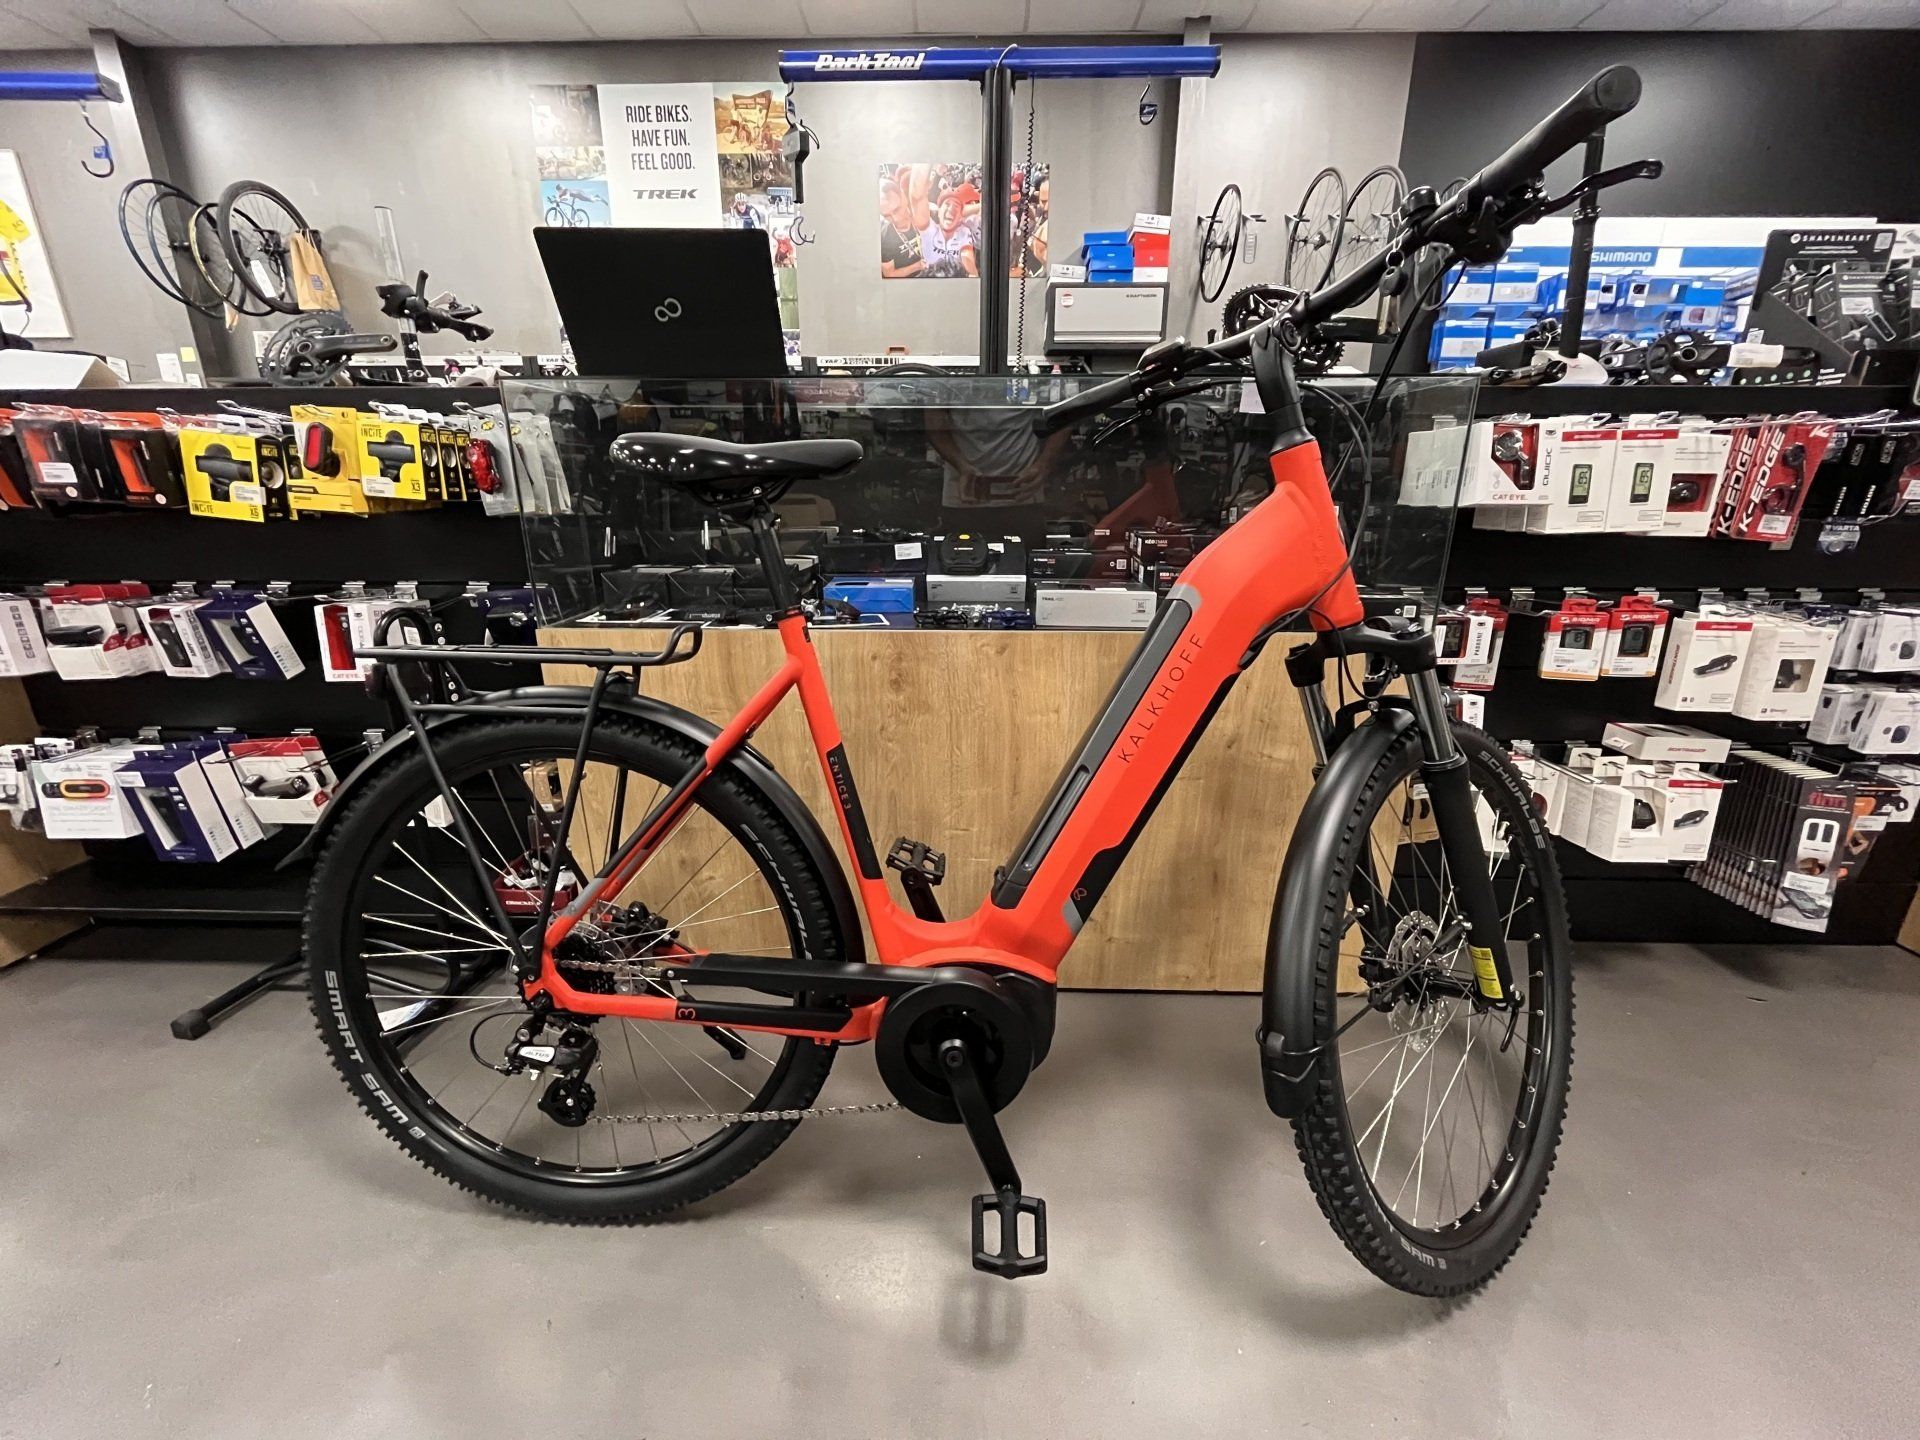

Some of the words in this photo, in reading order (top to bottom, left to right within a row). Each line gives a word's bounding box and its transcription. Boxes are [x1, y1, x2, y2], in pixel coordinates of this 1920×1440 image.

[625, 105, 653, 123] RIDE
[655, 103, 693, 123] BIKES.
[632, 128, 661, 147] HAVE
[664, 128, 691, 147] FUN.
[631, 153, 659, 171] FEEL
[660, 152, 696, 171] GOOD.
[633, 188, 699, 200] TREK
[1591, 251, 1653, 263] SHIMANO
[1542, 448, 1553, 486] QUICK
[1738, 427, 1786, 533] K-EDGE
[411, 482, 421, 492] X3
[1716, 433, 1758, 534] K-EDGE
[1832, 524, 1860, 532] VARTA
[1117, 632, 1204, 763] KALKHOFF
[829, 755, 849, 799] ENTICE
[1477, 750, 1546, 849] SCHWALBE
[324, 969, 364, 1064] SMART
[360, 1072, 410, 1125] SAM
[1399, 1236, 1435, 1268] SAM
